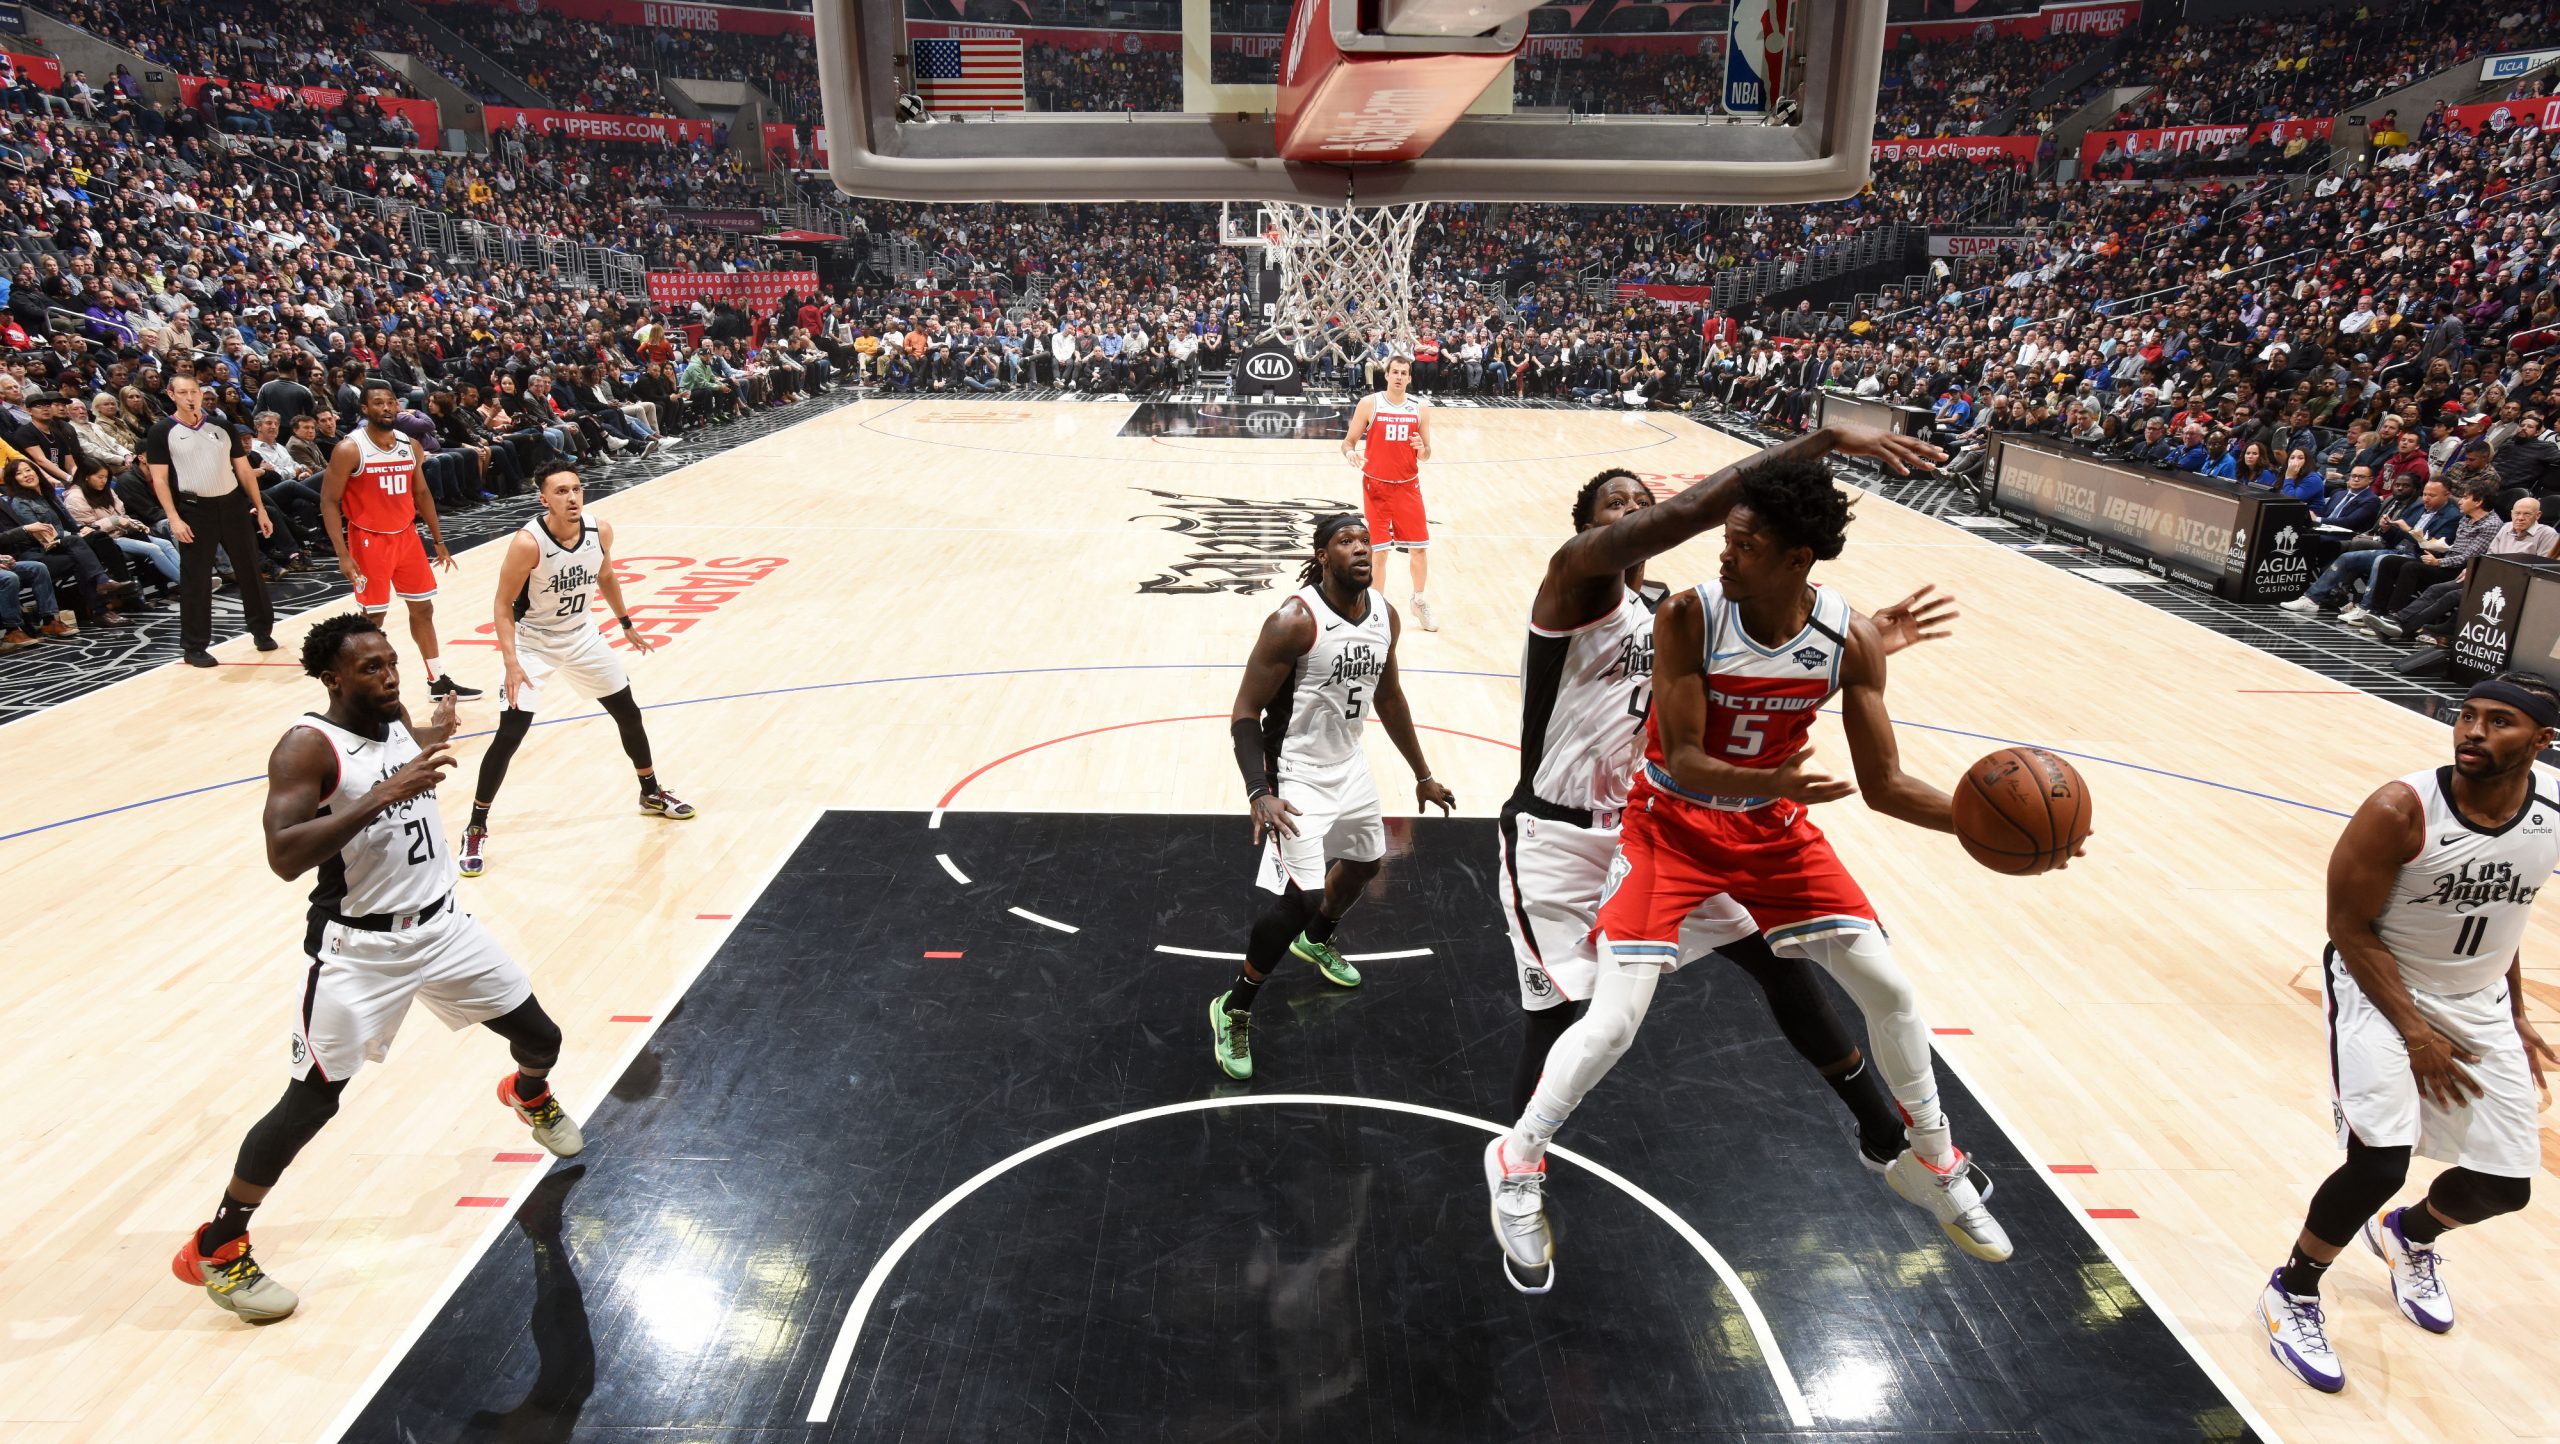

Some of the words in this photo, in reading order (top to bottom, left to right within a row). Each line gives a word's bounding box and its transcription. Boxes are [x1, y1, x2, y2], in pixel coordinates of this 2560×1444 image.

[0, 16, 19, 24] ESS
[660, 6, 719, 30] CLIPPERS
[2066, 8, 2125, 34] CLIPPERS
[2498, 62, 2524, 72] UCLA
[182, 78, 195, 86] 114
[1731, 81, 1759, 105] NBA
[2447, 109, 2459, 117] 118
[543, 116, 665, 139] CLIPPERS.COM
[2315, 121, 2328, 129] 117
[1905, 143, 2001, 159] @LAClippers
[712, 218, 755, 226] EXPRESS
[763, 226, 780, 235] EXIT
[1948, 238, 2019, 255] STAPLS
[1254, 362, 1285, 376] KIA
[1385, 424, 1409, 441] 88
[366, 463, 414, 474] SACTOWN
[379, 474, 407, 496] 40
[2054, 480, 2096, 513] NECA
[2102, 495, 2161, 531] IBEW
[2158, 513, 2174, 537] &
[2174, 516, 2233, 555] NECA
[2113, 522, 2134, 536] LOCAL
[2175, 543, 2190, 554] LOS
[2191, 548, 2225, 567] ANGELES
[2228, 547, 2246, 560] AGUA
[560, 564, 583, 580] Los
[2107, 546, 2144, 566] JoinHoney.com
[2171, 568, 2214, 591] JoinHoney.com
[2257, 556, 2307, 574] AGUA
[540, 570, 598, 596] Angeles
[2255, 573, 2307, 585] CALIENTE
[2258, 584, 2300, 594] CASINOS
[556, 593, 586, 617] 20
[2459, 621, 2507, 651] AGUA
[1343, 641, 1371, 662] Los
[2455, 640, 2505, 665] CALIENTE
[1793, 658, 1827, 667] ALMONDS
[2456, 656, 2496, 674] CASINOS
[1345, 686, 1362, 720] 5
[1709, 689, 1821, 711] ACTOWN
[1726, 714, 1769, 756] 5
[2522, 826, 2553, 835] bumble
[404, 817, 435, 866] 21
[2454, 857, 2514, 885] Los
[2453, 915, 2489, 957] 11
